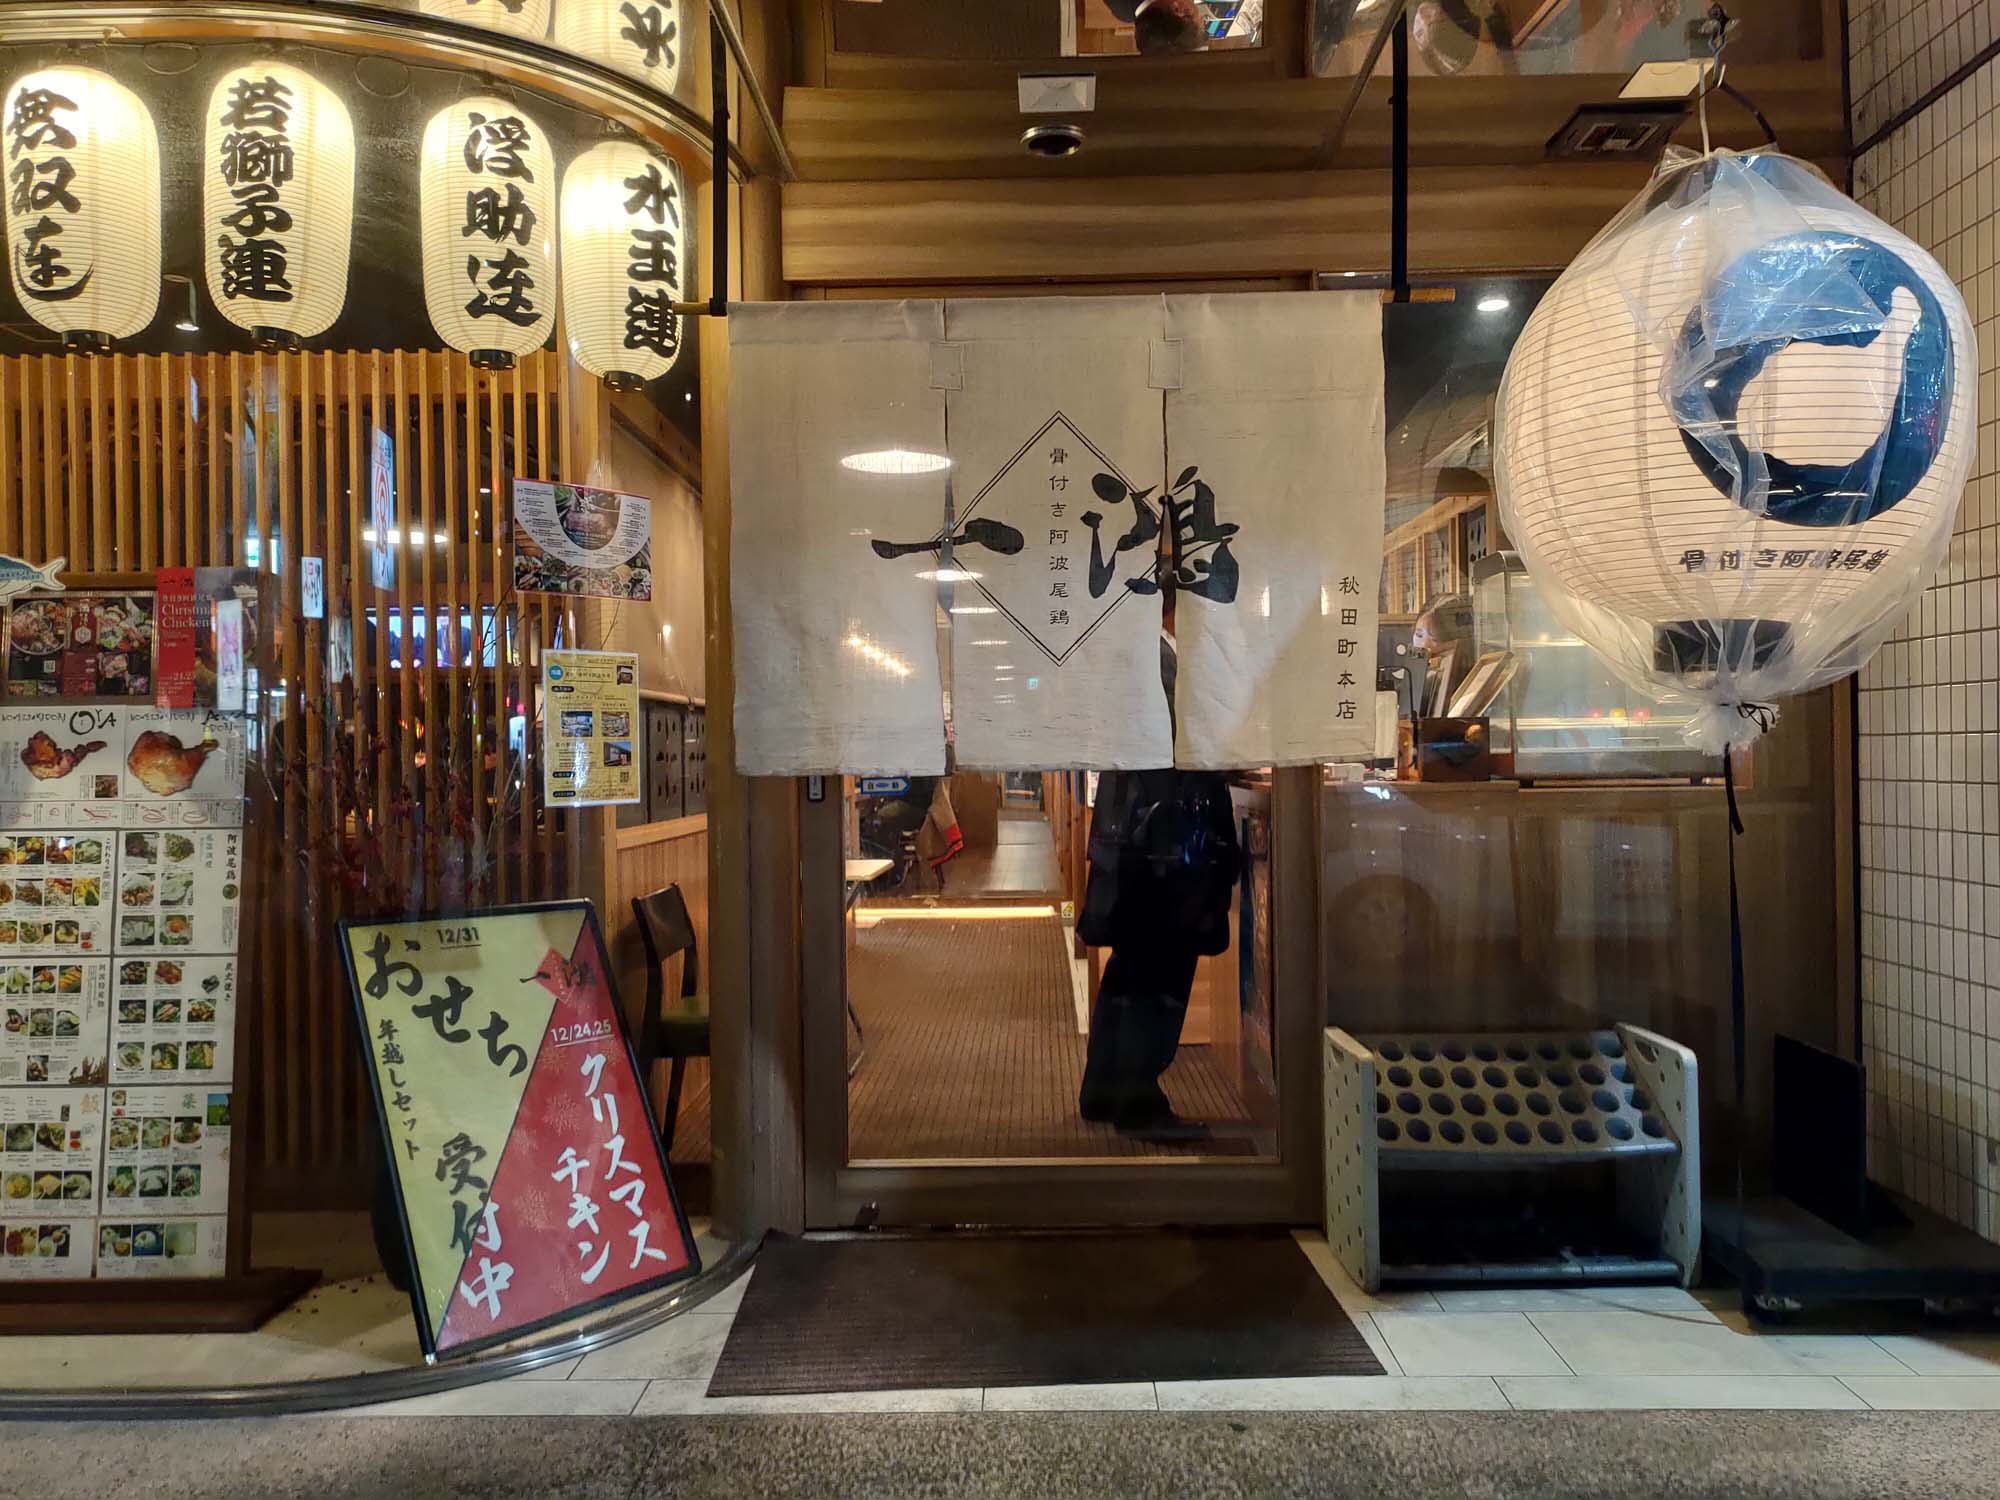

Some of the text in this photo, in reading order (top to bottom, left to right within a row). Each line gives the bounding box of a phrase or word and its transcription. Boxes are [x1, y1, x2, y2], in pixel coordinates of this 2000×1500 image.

[218, 76, 294, 303] 若獅子連
[1335, 575, 1360, 720] 秋田町本店
[363, 931, 528, 1078] おせち
[437, 927, 480, 944] 12/31
[377, 1018, 420, 1161] 年越しセット
[550, 1019, 612, 1042] 12/24.25
[435, 1132, 514, 1321] 受付中
[551, 1147, 611, 1284] チキン
[580, 1053, 667, 1269] クリスマス
